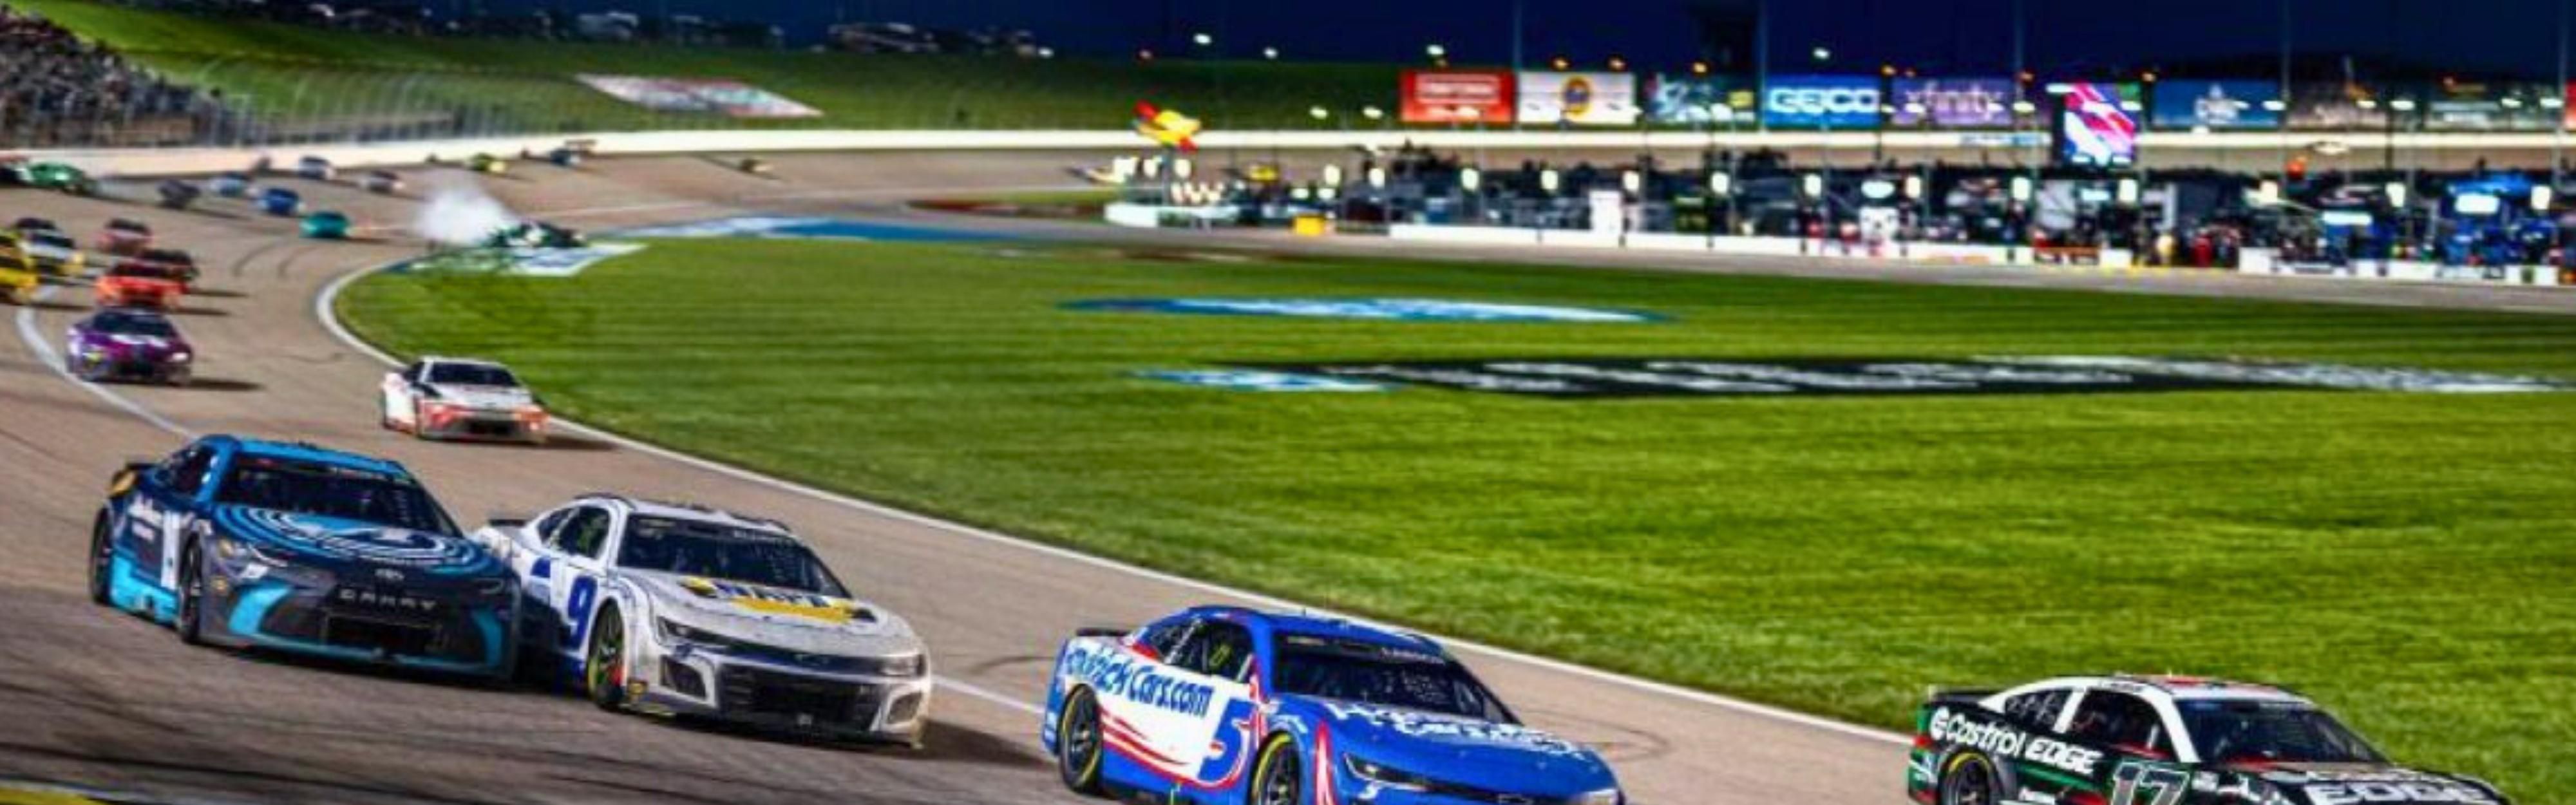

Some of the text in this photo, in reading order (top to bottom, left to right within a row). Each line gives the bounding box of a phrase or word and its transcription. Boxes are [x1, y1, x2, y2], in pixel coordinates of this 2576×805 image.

[1770, 86, 1880, 113] GEICO
[567, 574, 598, 650] 9
[1197, 696, 1258, 781] 5
[1946, 712, 2105, 774] Castrol EDGE
[2110, 761, 2190, 805] 17
